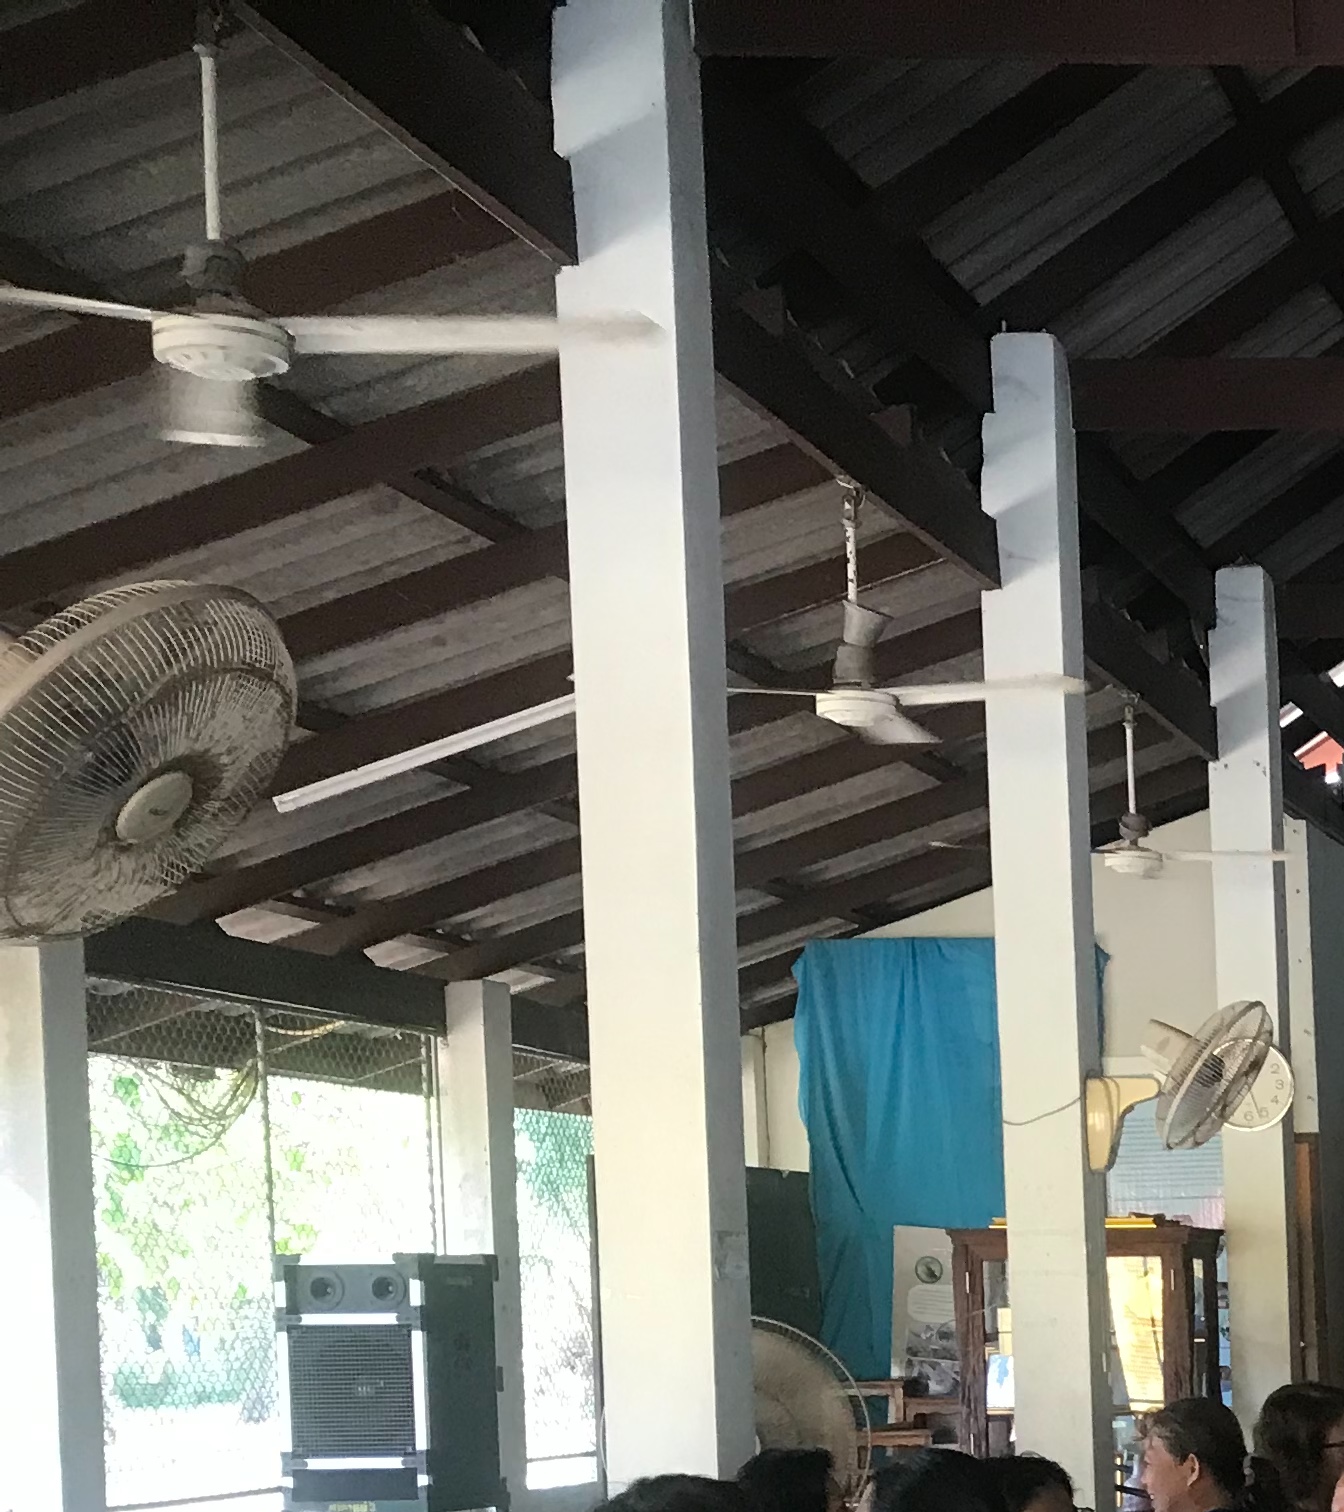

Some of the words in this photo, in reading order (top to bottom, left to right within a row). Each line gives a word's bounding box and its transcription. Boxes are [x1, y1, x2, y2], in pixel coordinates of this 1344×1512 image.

[1270, 1063, 1280, 1075] 2
[1275, 1080, 1285, 1091] 3
[1270, 1095, 1280, 1105] 4
[1243, 1111, 1254, 1122] 6
[1260, 1107, 1270, 1119] 5
